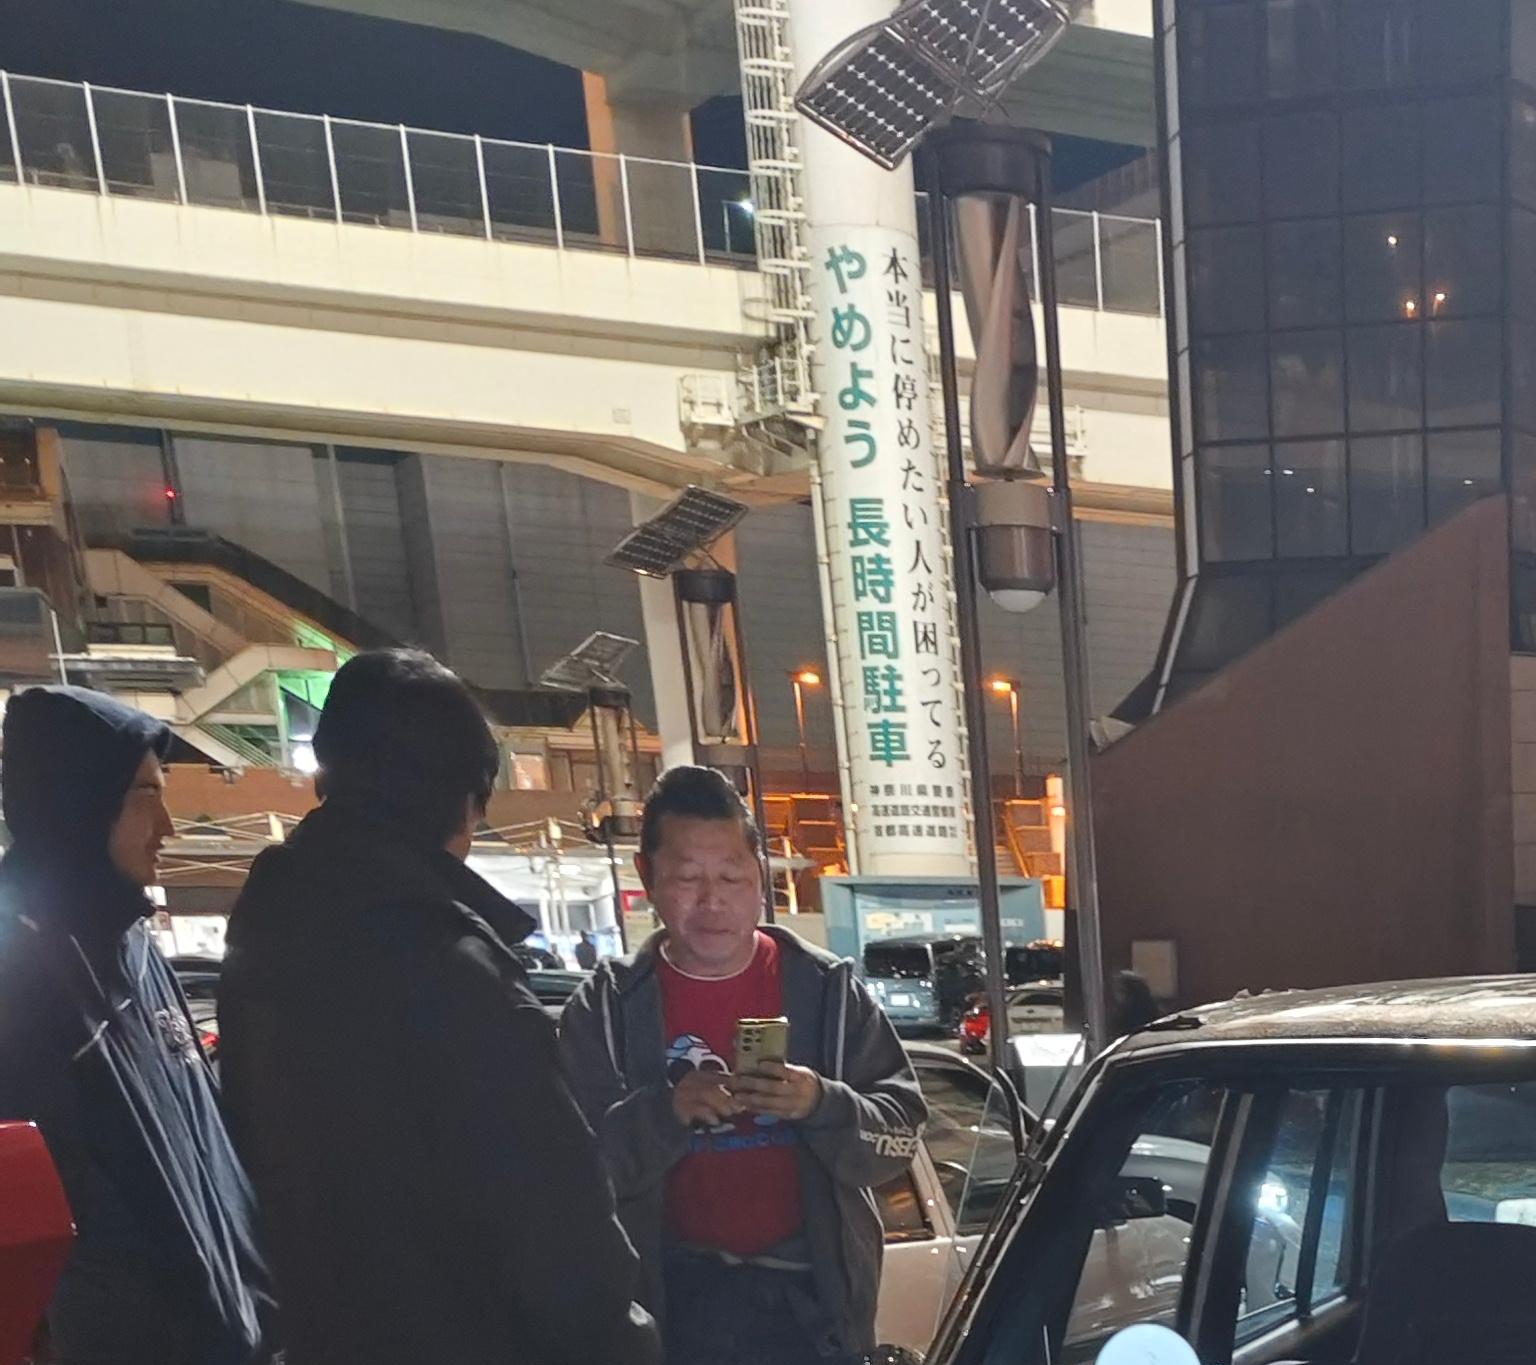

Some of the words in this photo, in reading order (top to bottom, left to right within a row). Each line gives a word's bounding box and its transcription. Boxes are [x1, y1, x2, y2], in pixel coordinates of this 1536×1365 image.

[824, 244, 878, 469] やめよう
[846, 497, 911, 768] 長時間駐車
[883, 247, 946, 769] 本当に停めたい人が困ってる
